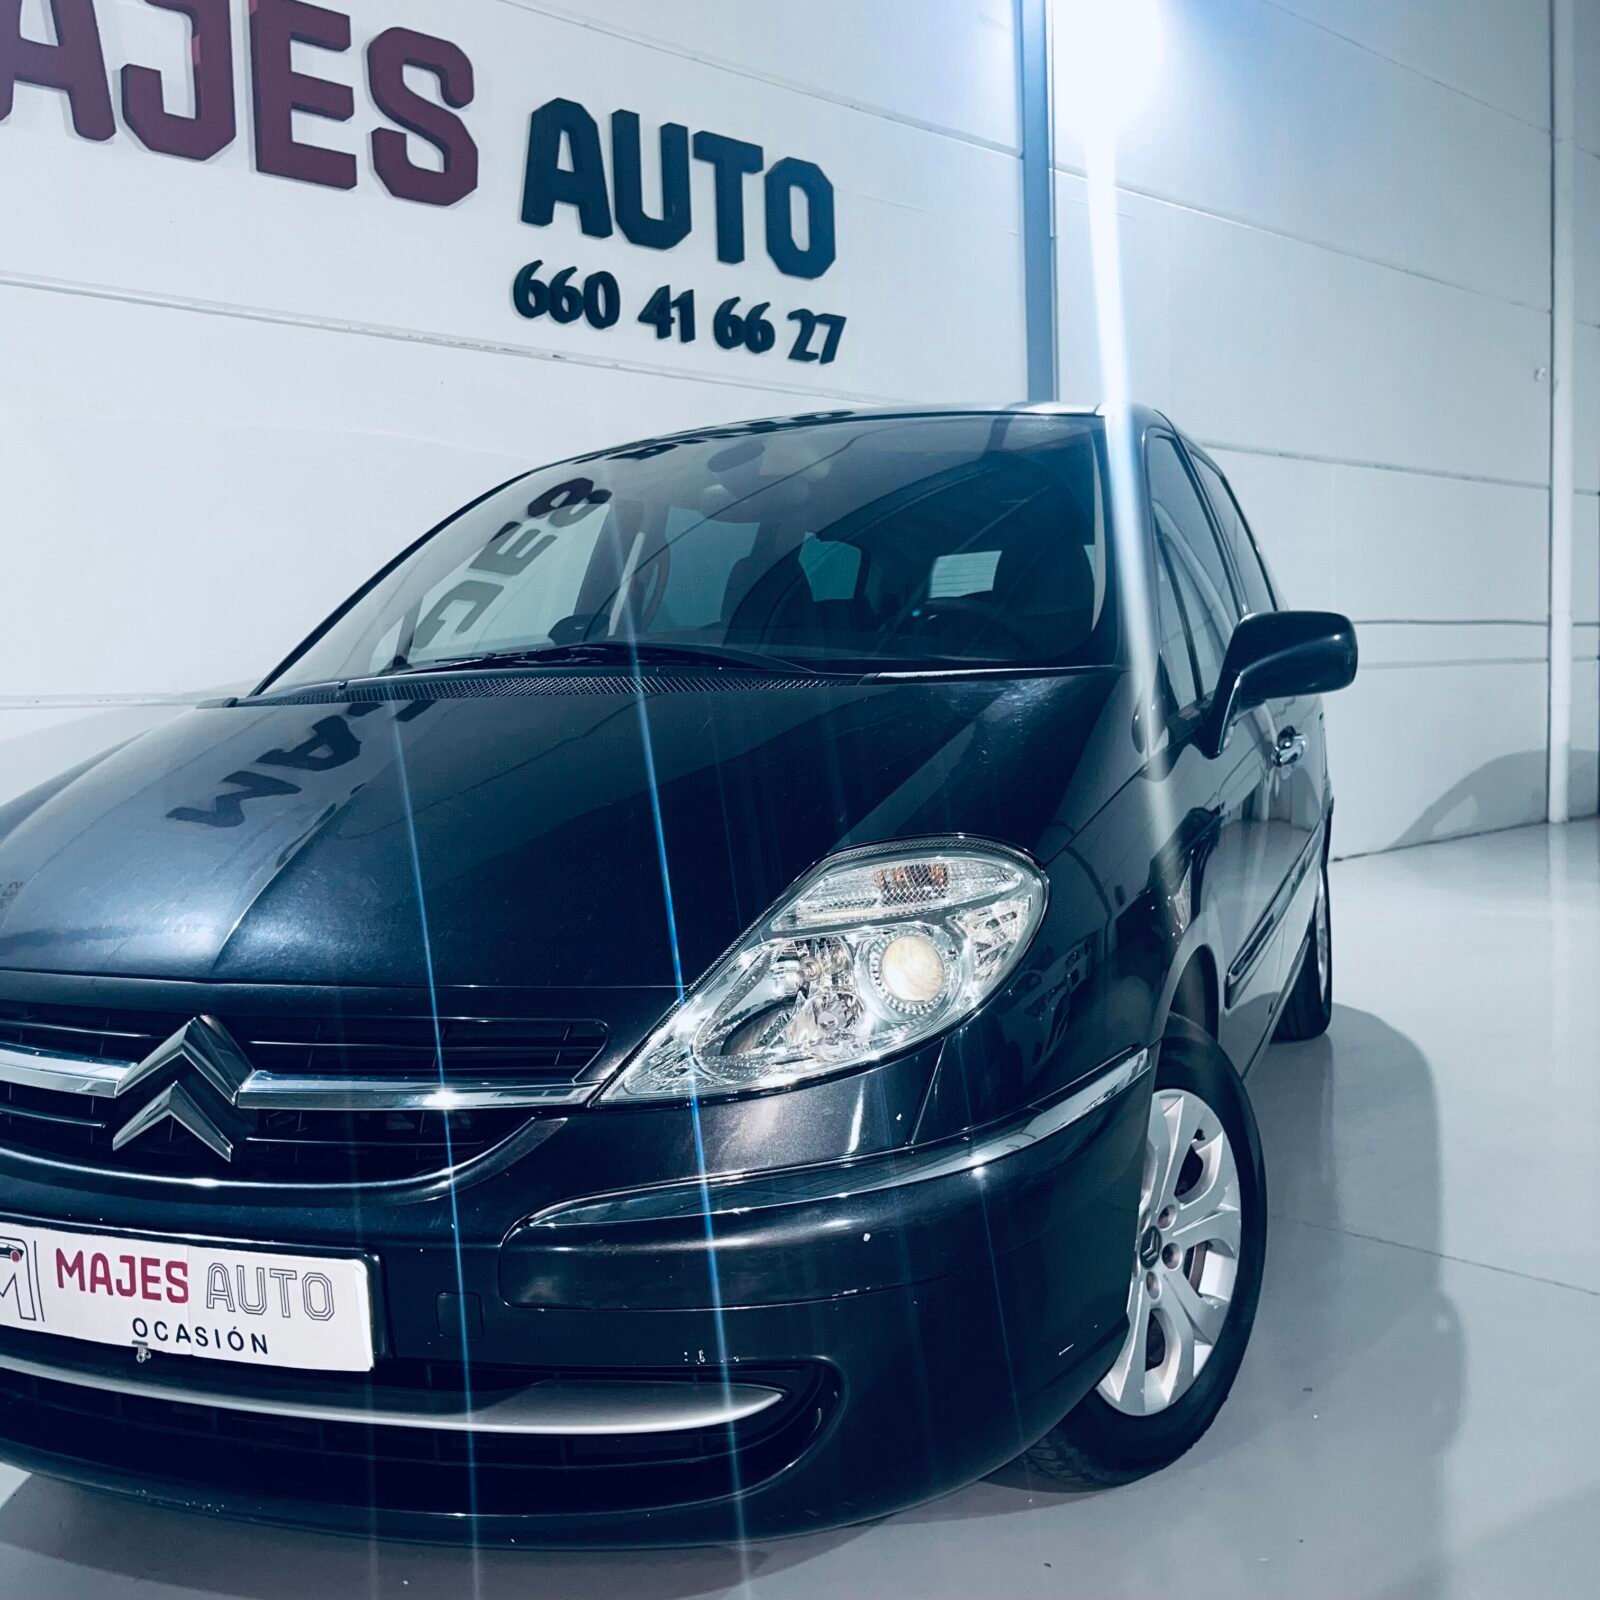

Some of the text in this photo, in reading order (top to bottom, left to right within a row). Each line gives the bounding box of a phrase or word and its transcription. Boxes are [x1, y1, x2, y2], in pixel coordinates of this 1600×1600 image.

[520, 97, 836, 280] AUTO
[512, 259, 847, 365] 660 41 66 27
[55, 1247, 189, 1304] MAJES
[206, 1262, 335, 1321] AUTO
[132, 1317, 269, 1354] OCASIÓN
